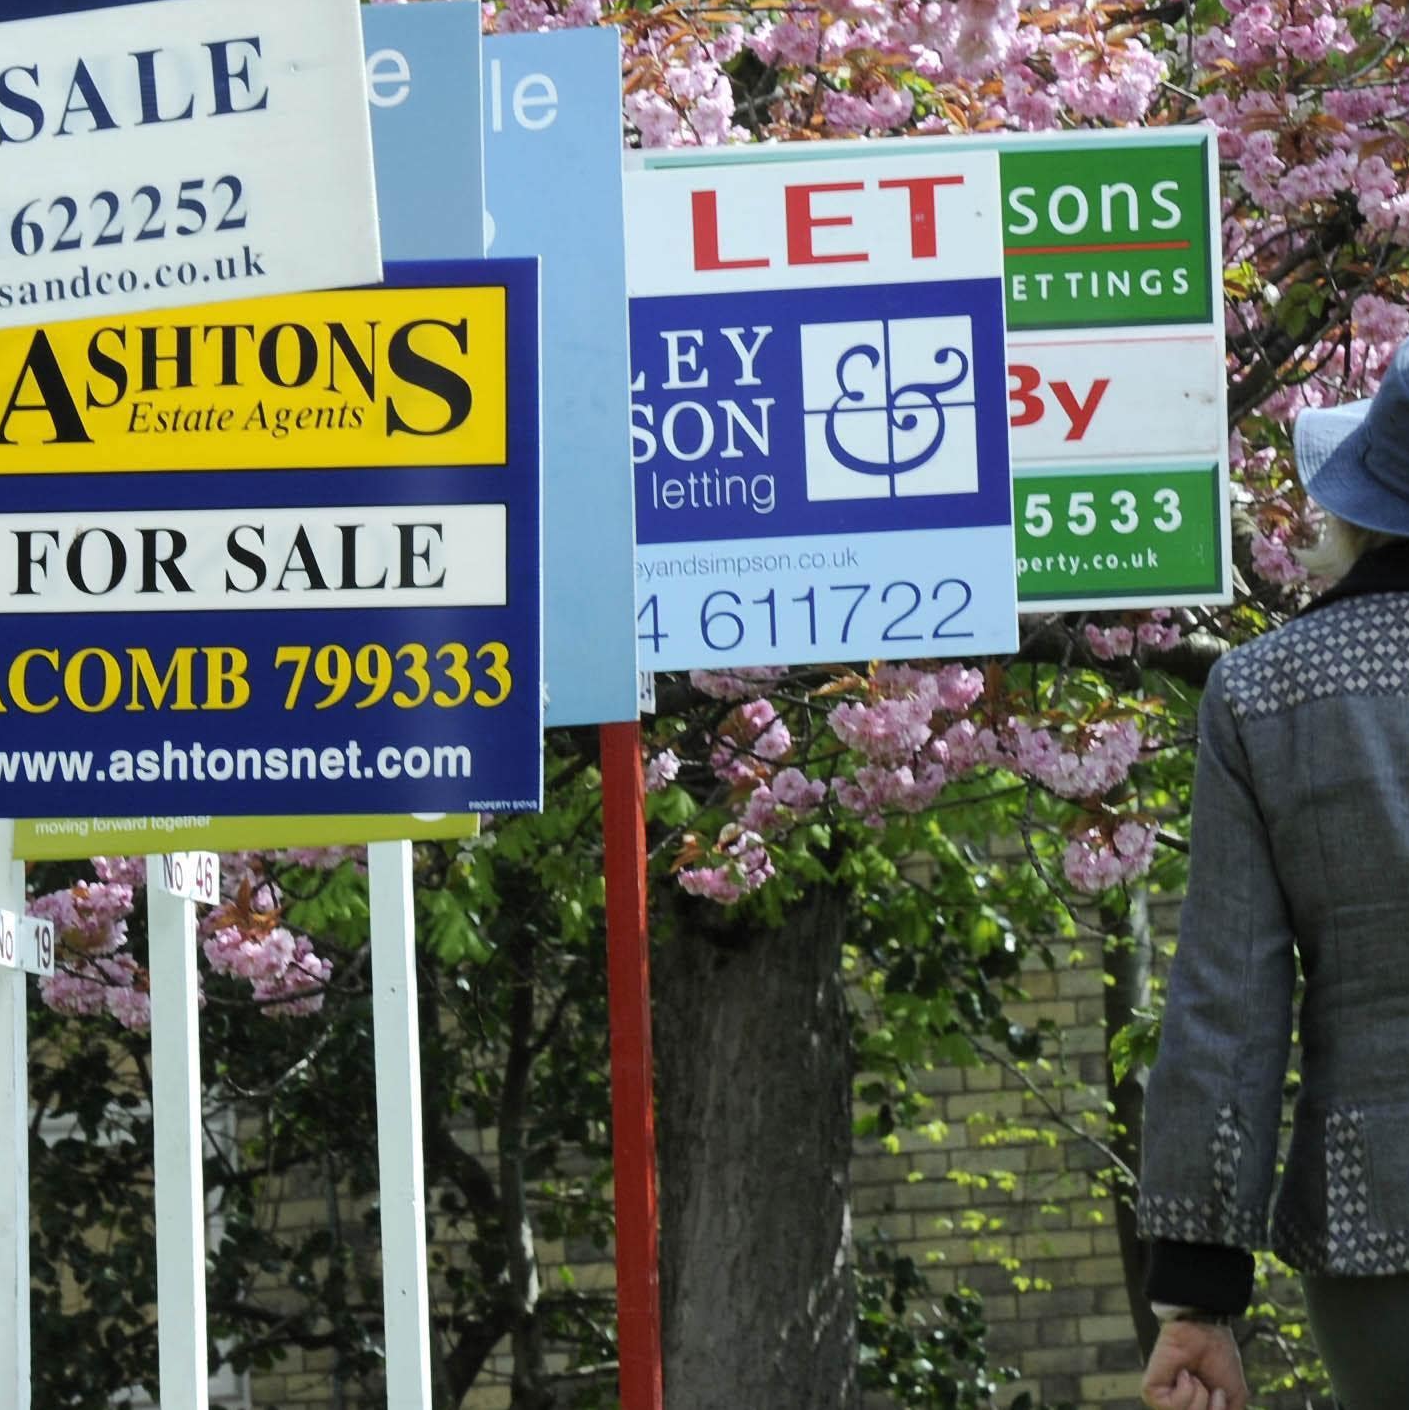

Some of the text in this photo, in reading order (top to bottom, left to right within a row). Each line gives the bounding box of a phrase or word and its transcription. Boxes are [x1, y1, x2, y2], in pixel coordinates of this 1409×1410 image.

[10, 173, 248, 259] 622252
[690, 174, 965, 272] LET
[1007, 178, 1183, 236] sons
[1011, 267, 1190, 302] ETTINGS
[631, 325, 774, 392] EY
[127, 398, 366, 439] Estate Agents
[631, 397, 777, 465] SON
[1007, 363, 1112, 442] By
[651, 467, 777, 515] letting
[1023, 487, 1184, 538] 5533
[9, 521, 448, 597] FOR SALE
[1016, 547, 1159, 577] perty.co.uk
[699, 578, 976, 652] 611722
[274, 640, 514, 712] 799333
[35, 815, 212, 837] moving forward together
[162, 854, 214, 899] No 46
[34, 924, 52, 969] 19
